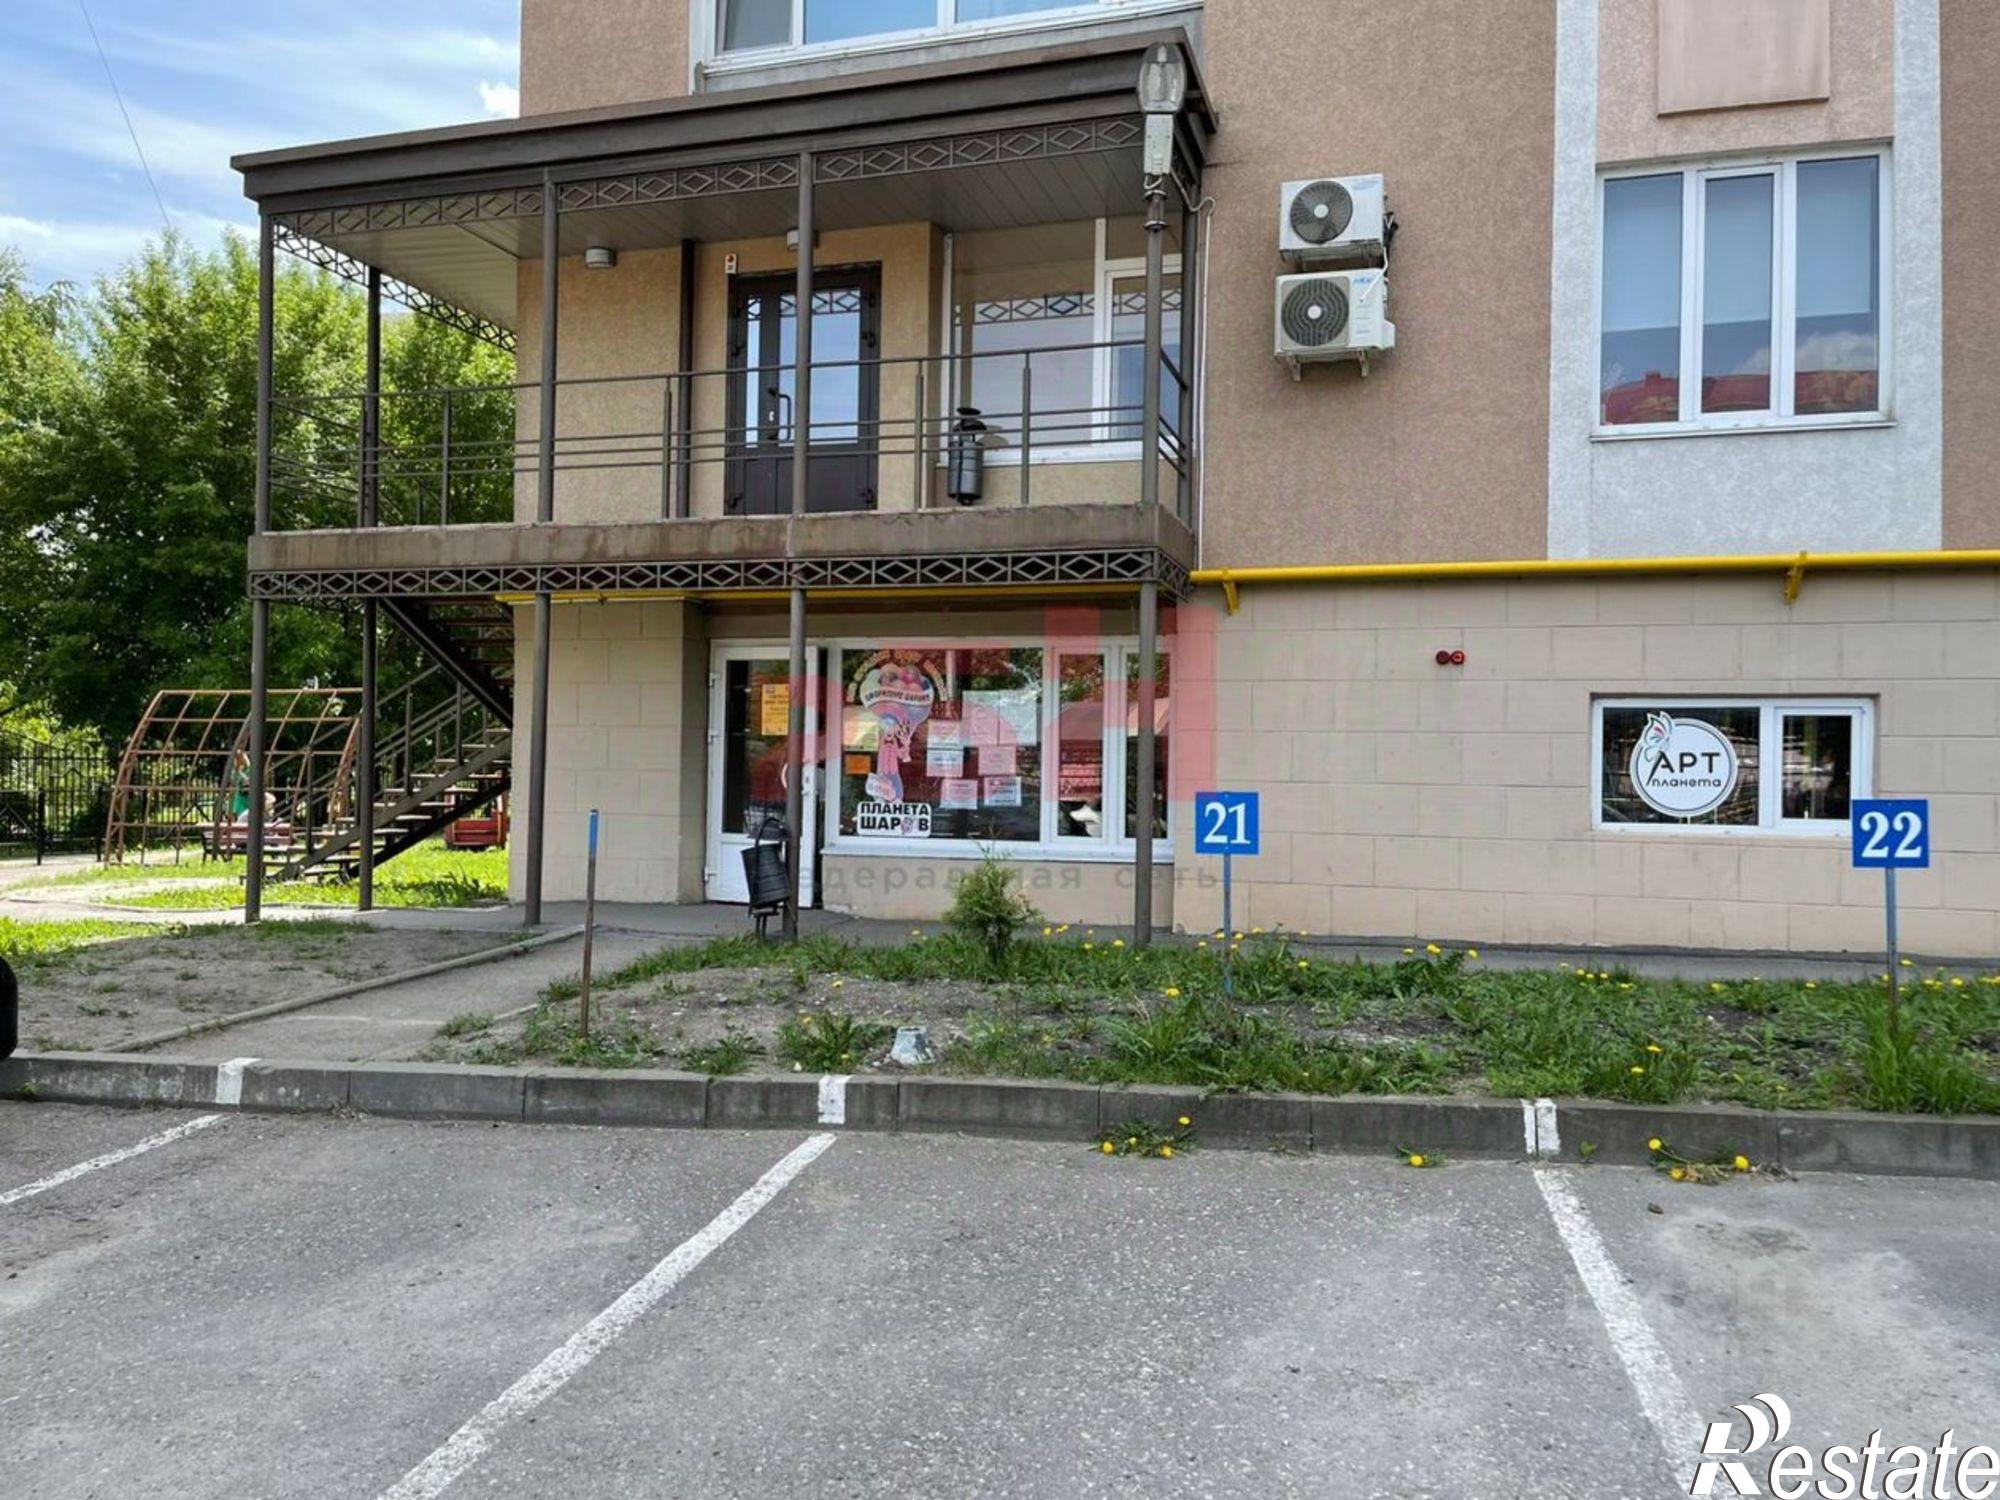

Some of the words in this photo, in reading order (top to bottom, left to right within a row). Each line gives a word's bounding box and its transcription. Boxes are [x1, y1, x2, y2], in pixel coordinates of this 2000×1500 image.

[1646, 750, 1720, 786] АРТ
[1652, 778, 1721, 788] планета
[861, 802, 929, 815] ПЛАНЕТА
[1203, 801, 1251, 844] 21
[1860, 811, 1922, 858] 22
